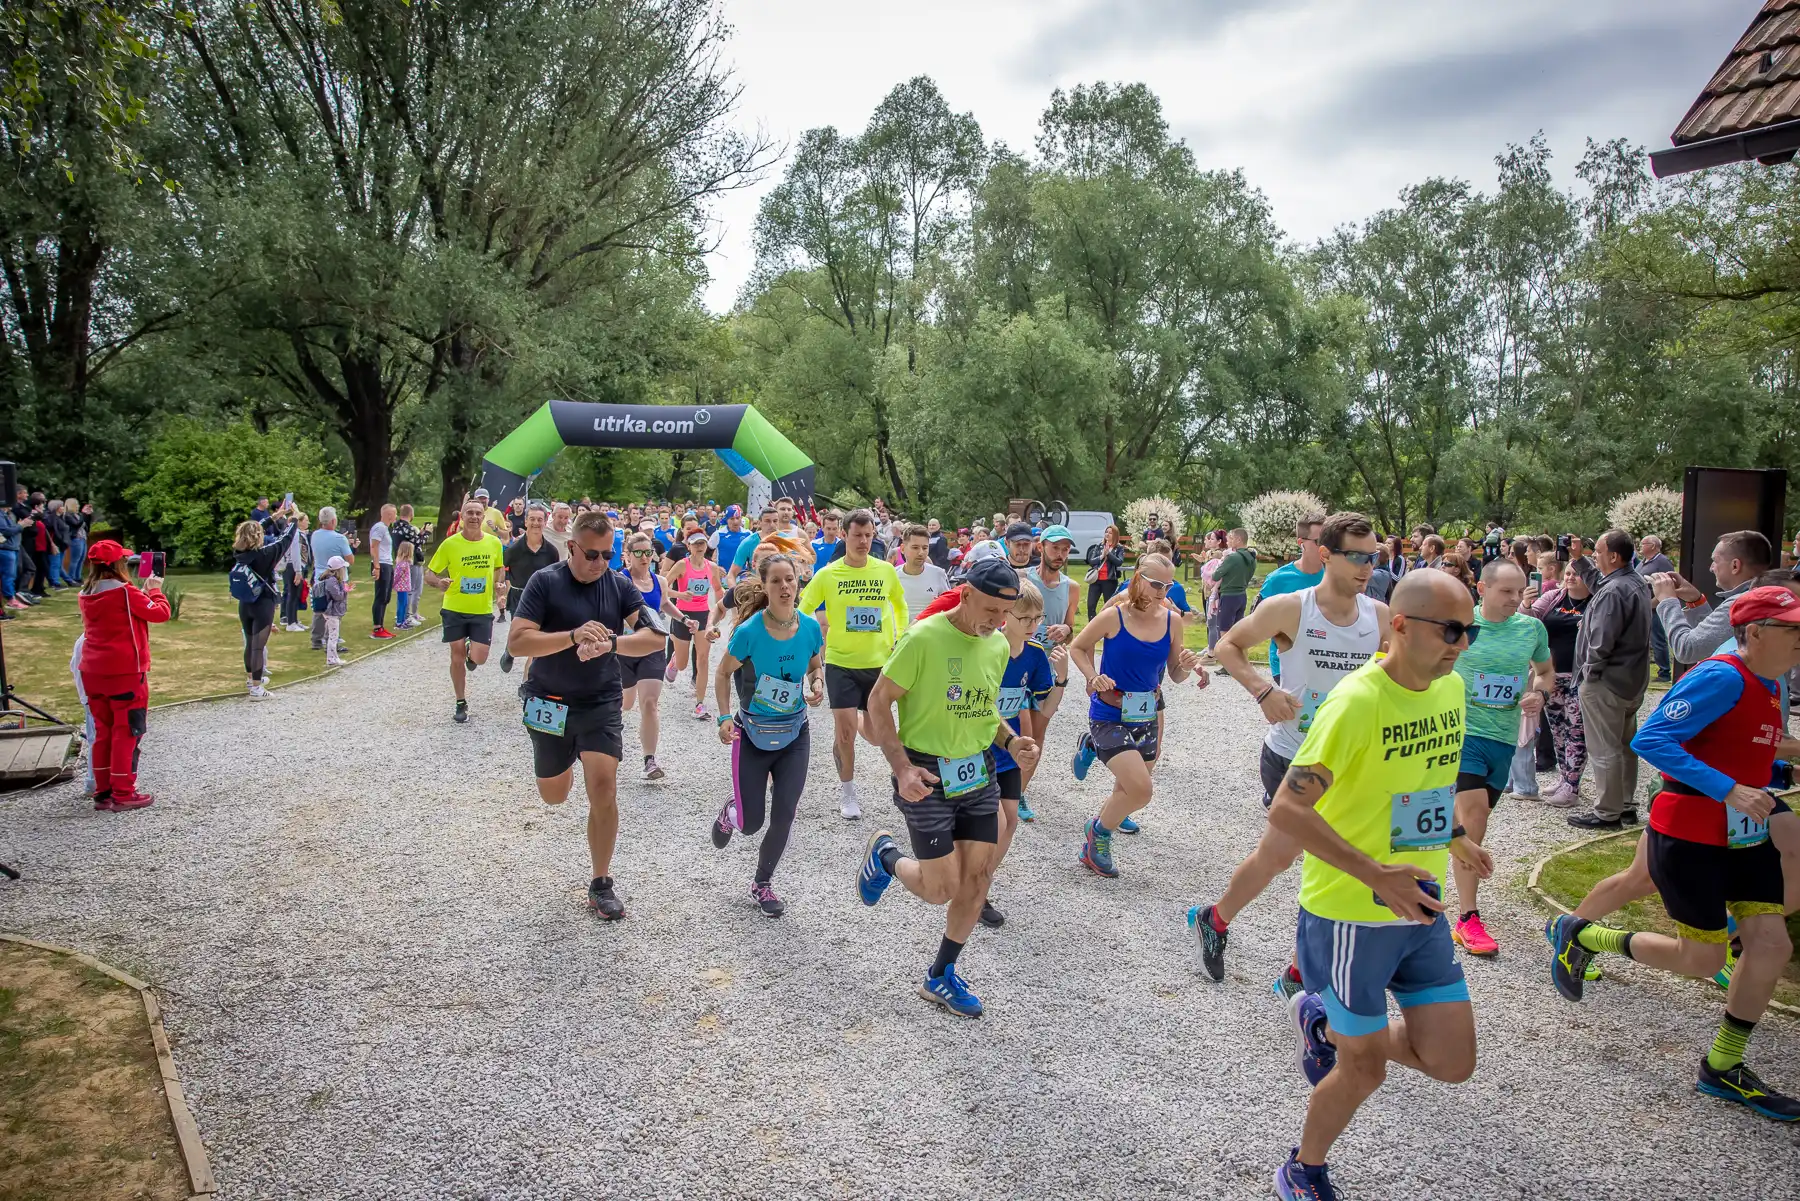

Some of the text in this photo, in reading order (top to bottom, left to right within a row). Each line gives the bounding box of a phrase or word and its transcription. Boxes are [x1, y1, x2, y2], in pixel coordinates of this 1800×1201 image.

[593, 414, 695, 434] utrka.com
[465, 582, 482, 590] 149
[694, 584, 705, 592] 60
[838, 580, 867, 588] PRIZMA
[853, 614, 876, 625] 190
[1308, 649, 1348, 659] ATLETSKI
[772, 688, 790, 703] 18
[1483, 684, 1513, 699] 178
[998, 697, 1021, 710] 177
[1139, 701, 1148, 713] 4
[535, 709, 553, 724] 13
[1382, 708, 1461, 745] PRIZMA V&V
[1384, 730, 1461, 761] running
[1426, 749, 1461, 770] Tea
[957, 762, 976, 782] 69
[1417, 806, 1447, 834] 65
